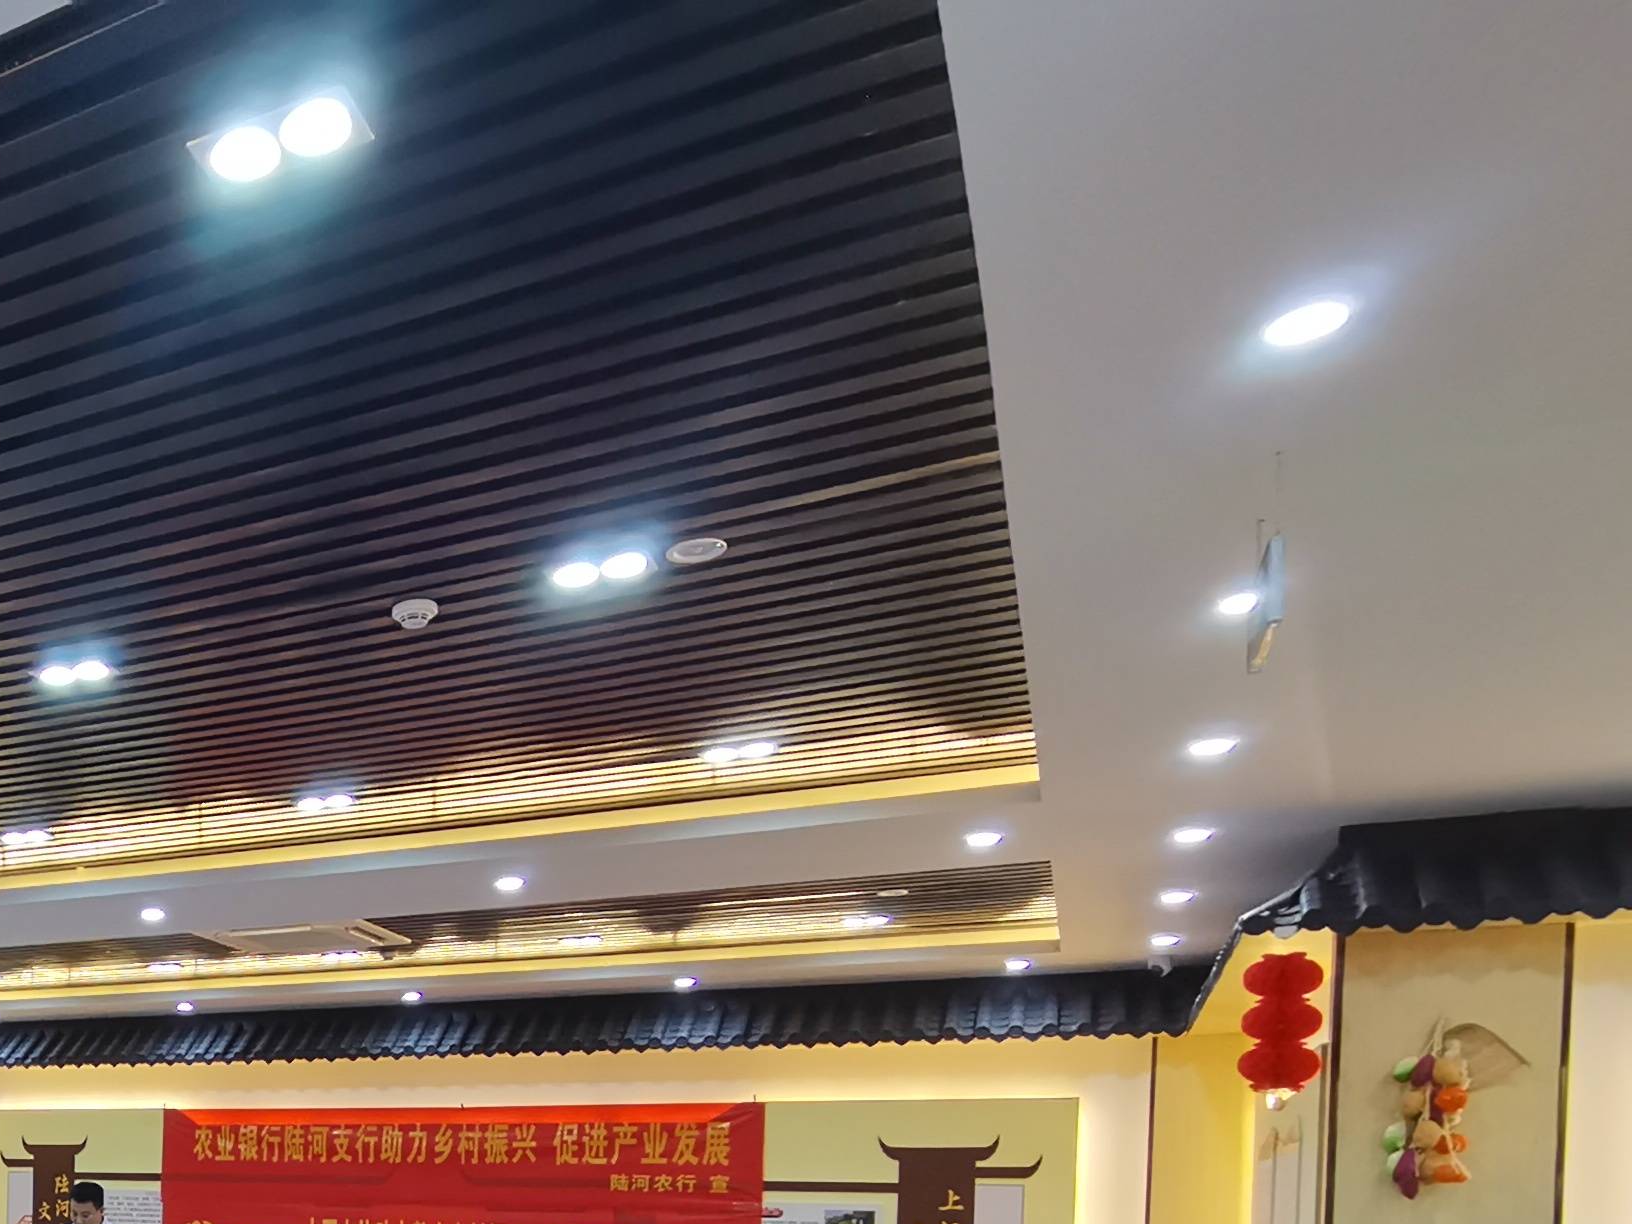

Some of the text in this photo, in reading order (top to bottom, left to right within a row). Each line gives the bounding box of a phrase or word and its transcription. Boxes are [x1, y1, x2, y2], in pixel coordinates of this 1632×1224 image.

[193, 1122, 731, 1166] 农业银行陆河支行助力乡村振兴 促进产业发展
[609, 1173, 730, 1194] 陆河农行 宣
